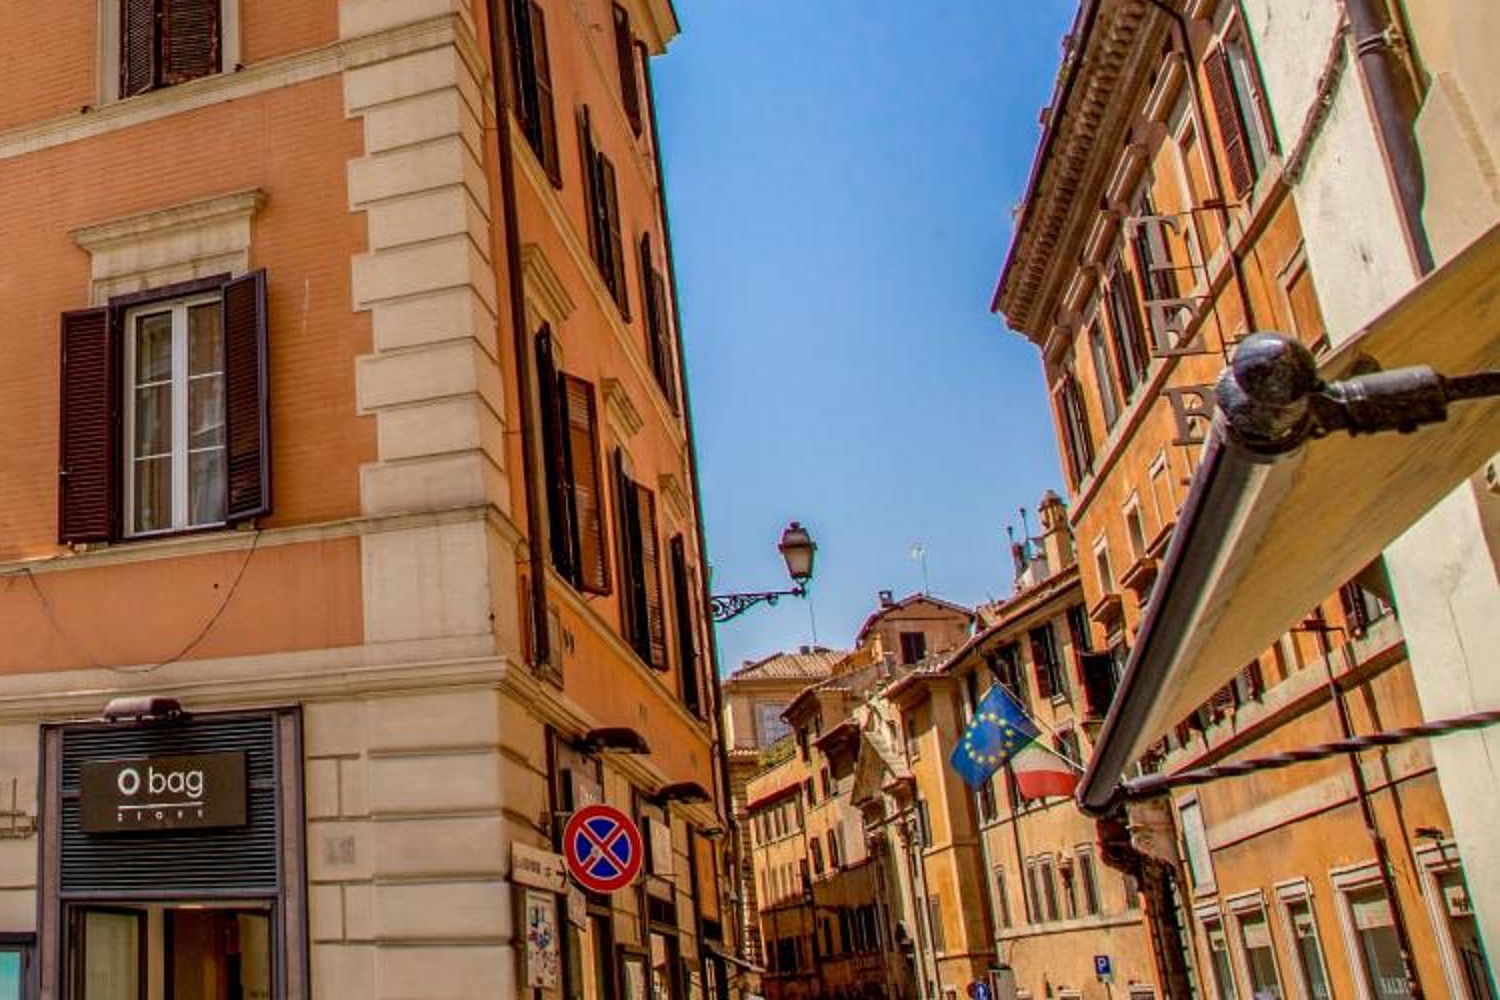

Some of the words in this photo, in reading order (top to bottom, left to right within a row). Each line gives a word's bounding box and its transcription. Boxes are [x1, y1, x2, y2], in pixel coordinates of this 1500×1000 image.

[117, 767, 141, 796] O
[148, 760, 204, 799] bag
[1097, 957, 1107, 973] P
